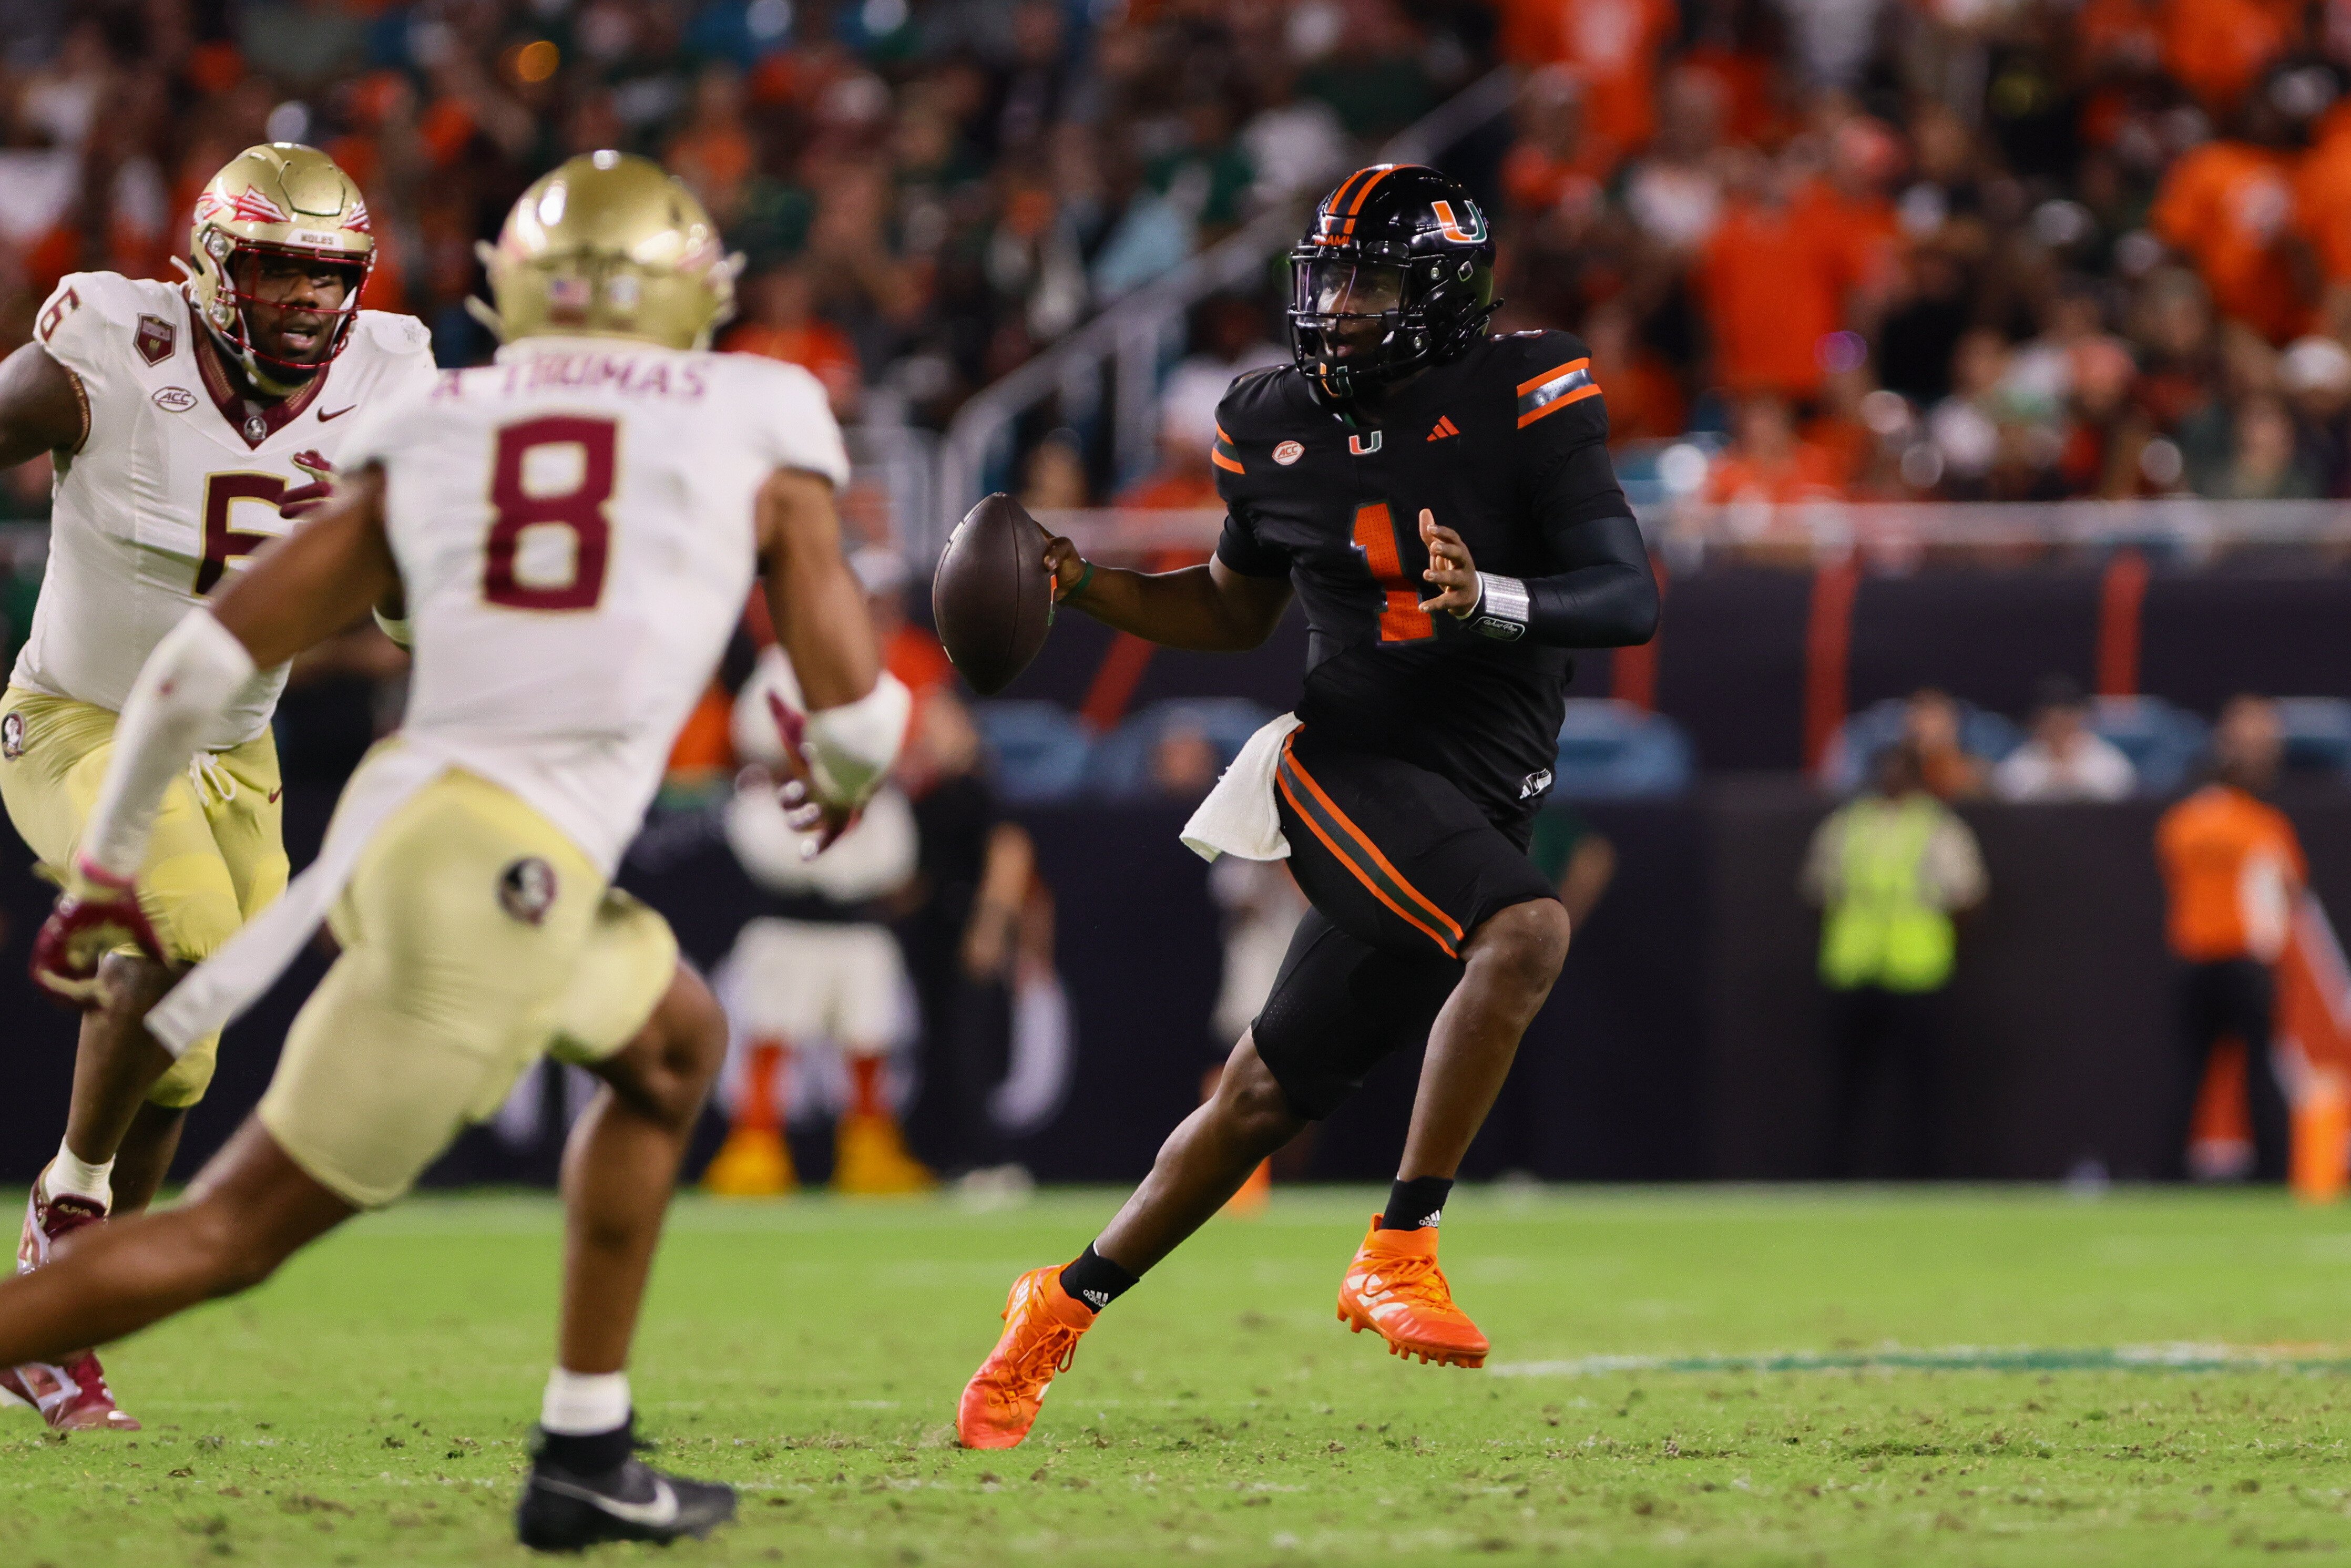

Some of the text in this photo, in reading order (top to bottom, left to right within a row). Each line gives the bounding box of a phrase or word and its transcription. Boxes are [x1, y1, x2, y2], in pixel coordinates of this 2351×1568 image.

[1430, 199, 1487, 243] U
[300, 233, 334, 245] NOLES
[39, 285, 81, 347] 6
[501, 349, 707, 404] THOMAS
[160, 392, 191, 403] ACC
[1277, 444, 1299, 457] ACC
[1348, 429, 1383, 455] U
[479, 412, 623, 614] 8
[1347, 499, 1438, 648] 1
[57, 1203, 93, 1217] ALPHA
[1083, 1289, 1106, 1308] adida
